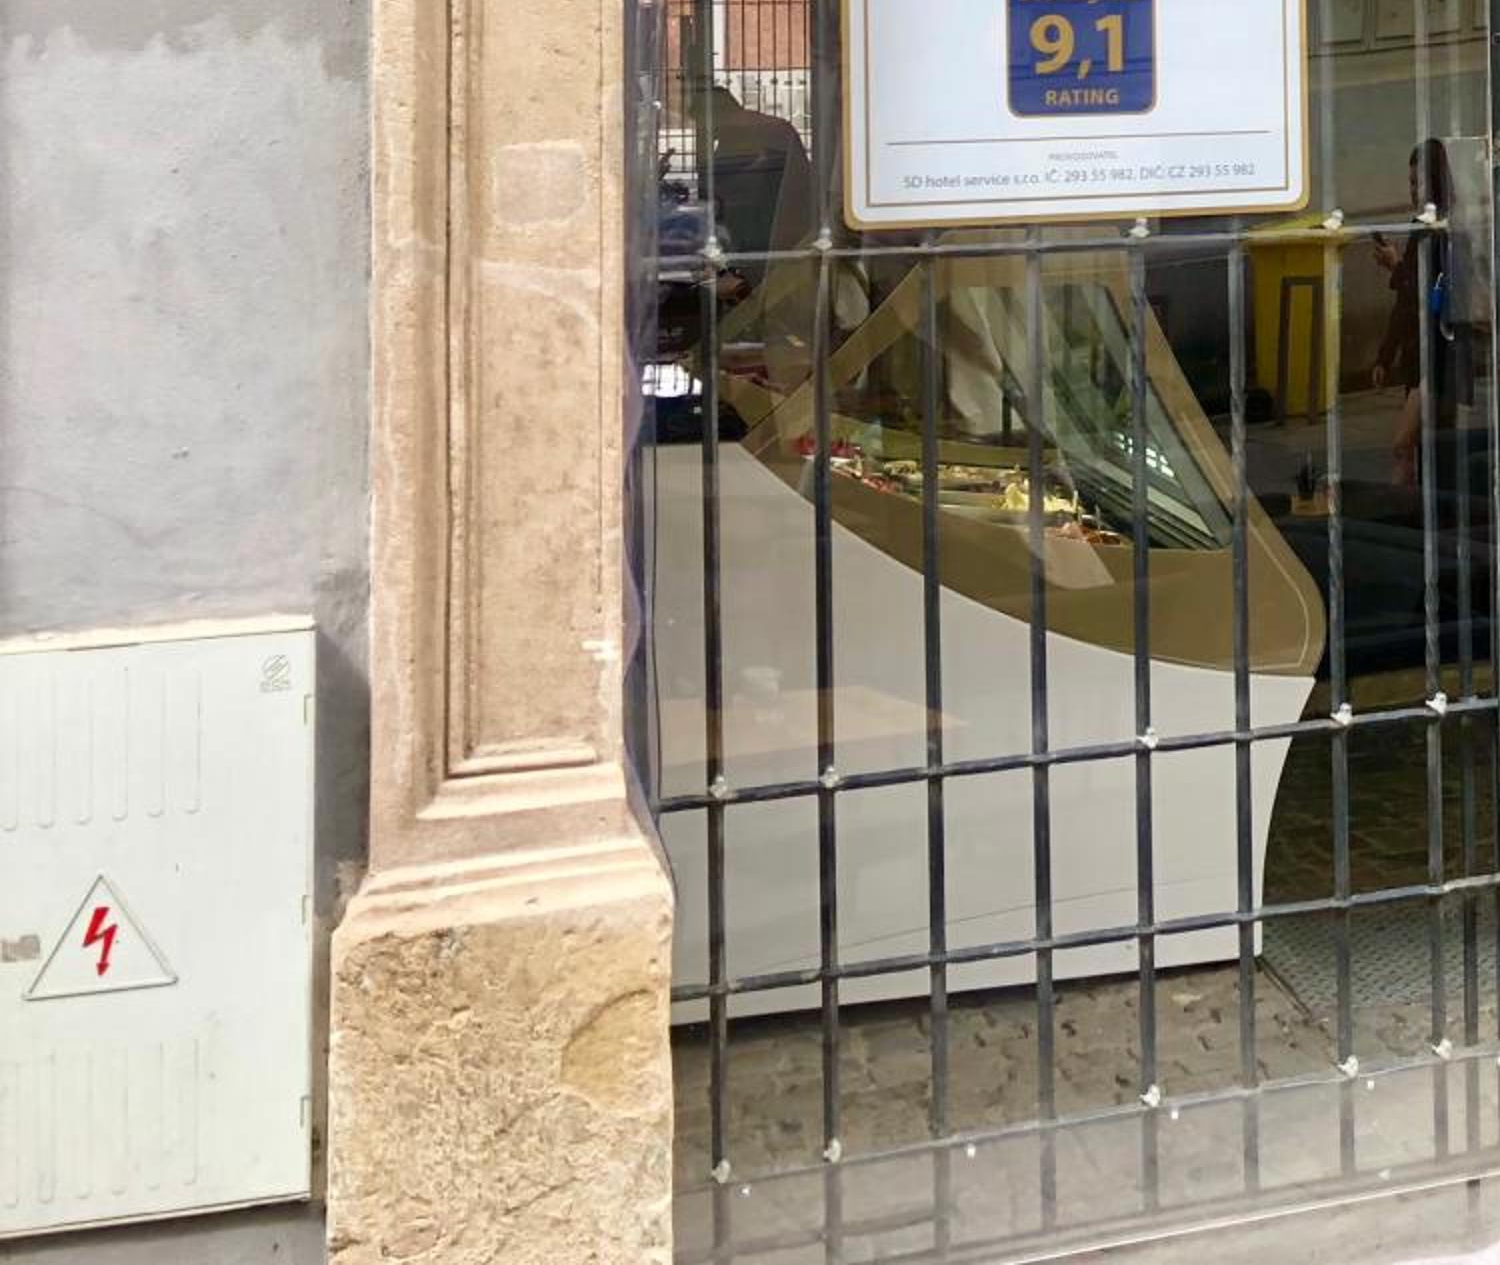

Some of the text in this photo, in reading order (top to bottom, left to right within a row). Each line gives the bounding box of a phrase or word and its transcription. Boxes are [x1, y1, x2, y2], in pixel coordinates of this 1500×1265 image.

[1029, 14, 1125, 80] 9,1
[1045, 88, 1120, 106] RATING
[926, 174, 960, 188] hotel
[964, 174, 1009, 186] service
[1215, 163, 1231, 176] 55
